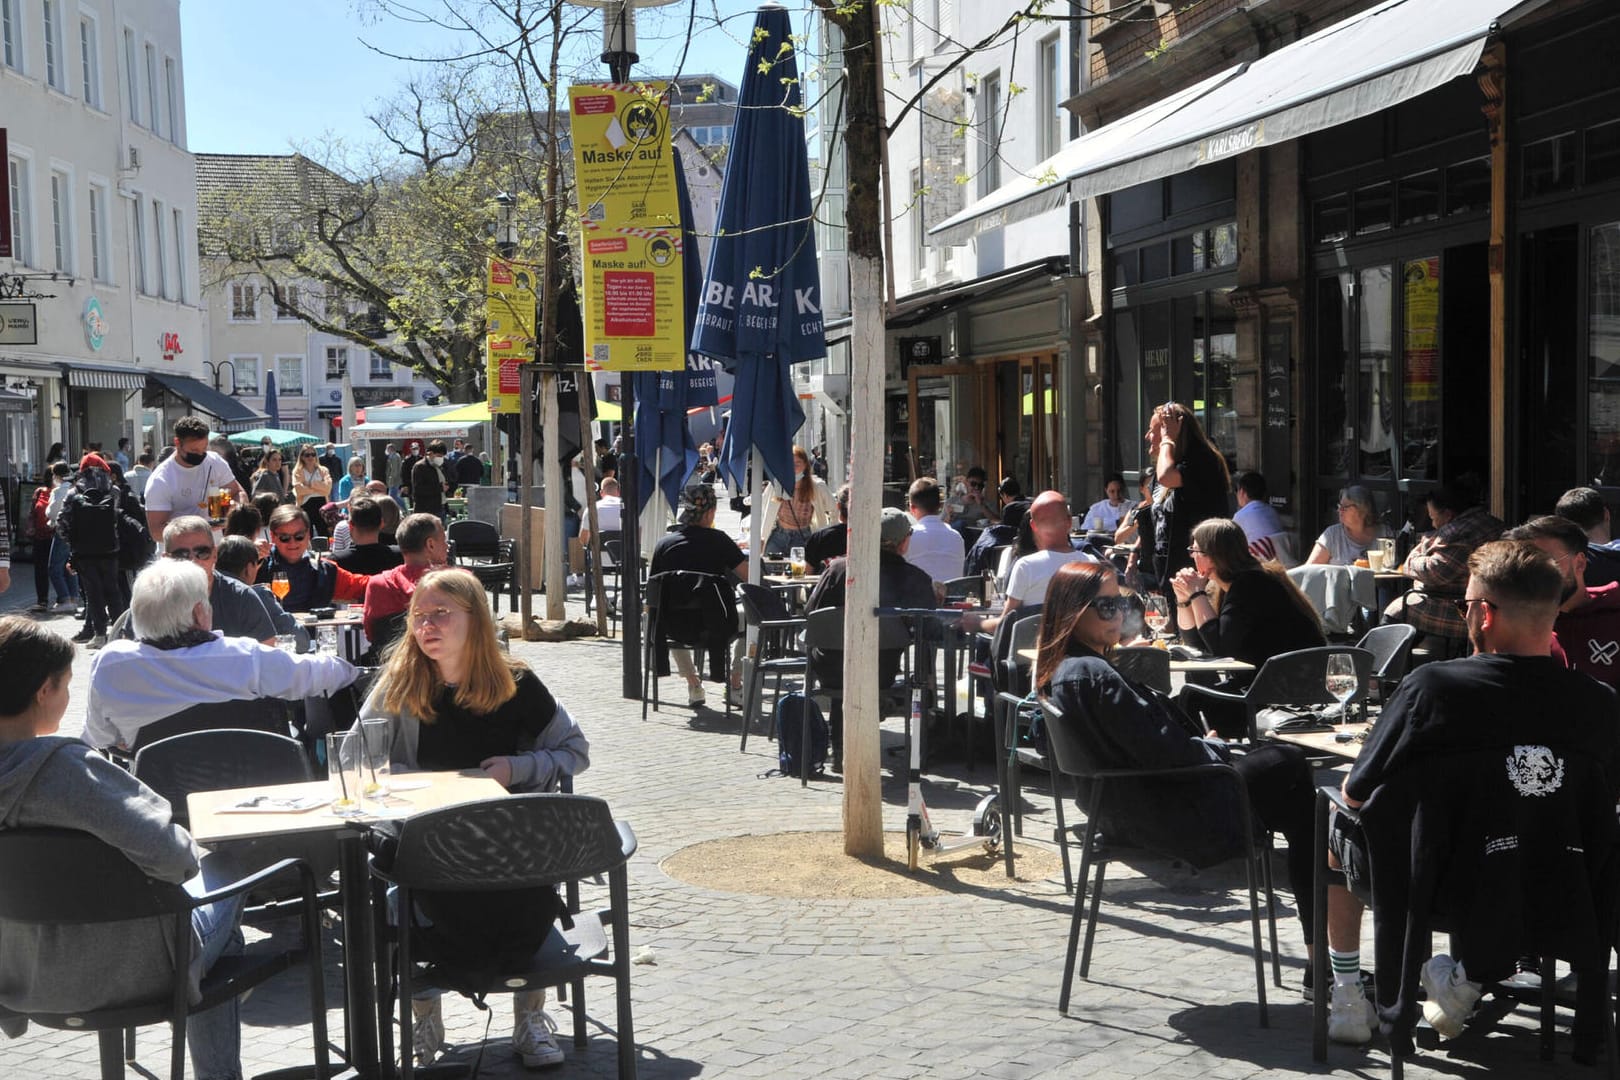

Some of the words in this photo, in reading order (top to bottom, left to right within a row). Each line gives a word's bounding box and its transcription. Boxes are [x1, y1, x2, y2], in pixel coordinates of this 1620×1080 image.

[1207, 126, 1255, 160] KARLSBERG
[583, 148, 632, 164] Maske
[592, 260, 625, 269] Maske
[627, 260, 647, 269] auf!
